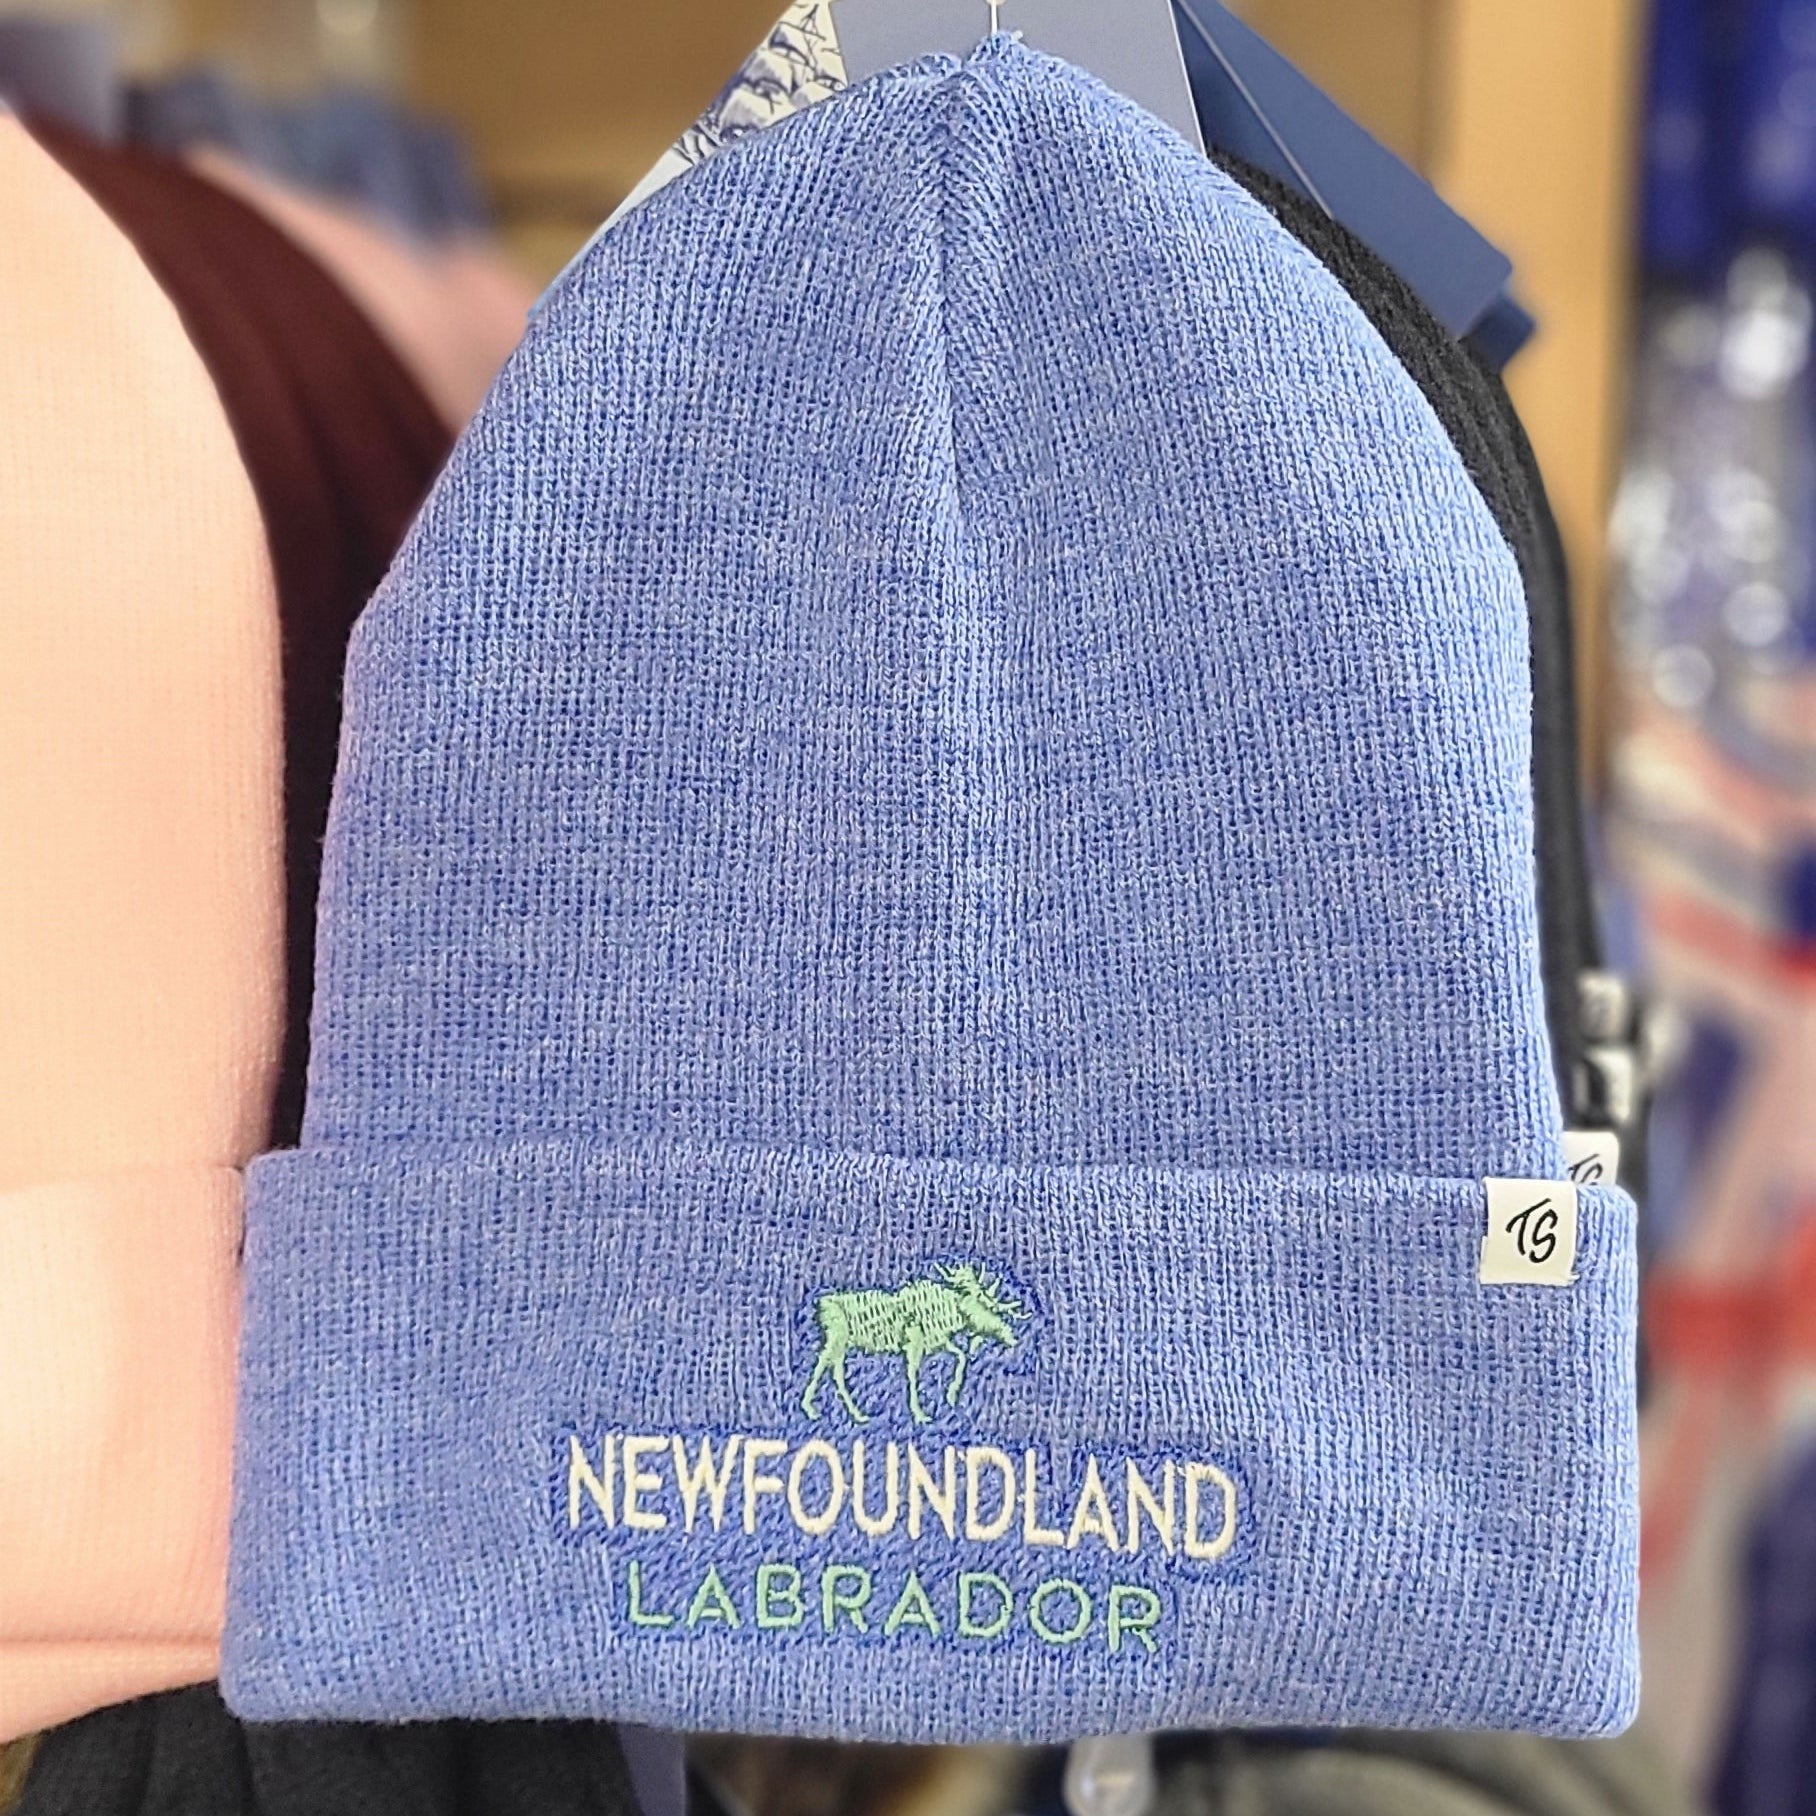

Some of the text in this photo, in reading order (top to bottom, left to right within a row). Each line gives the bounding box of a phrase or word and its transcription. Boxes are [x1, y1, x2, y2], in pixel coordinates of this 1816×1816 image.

[1505, 1198, 1558, 1264] TS
[567, 1434, 1238, 1558] NEWFOUNDLAND
[627, 1560, 1162, 1653] LABRADOR
